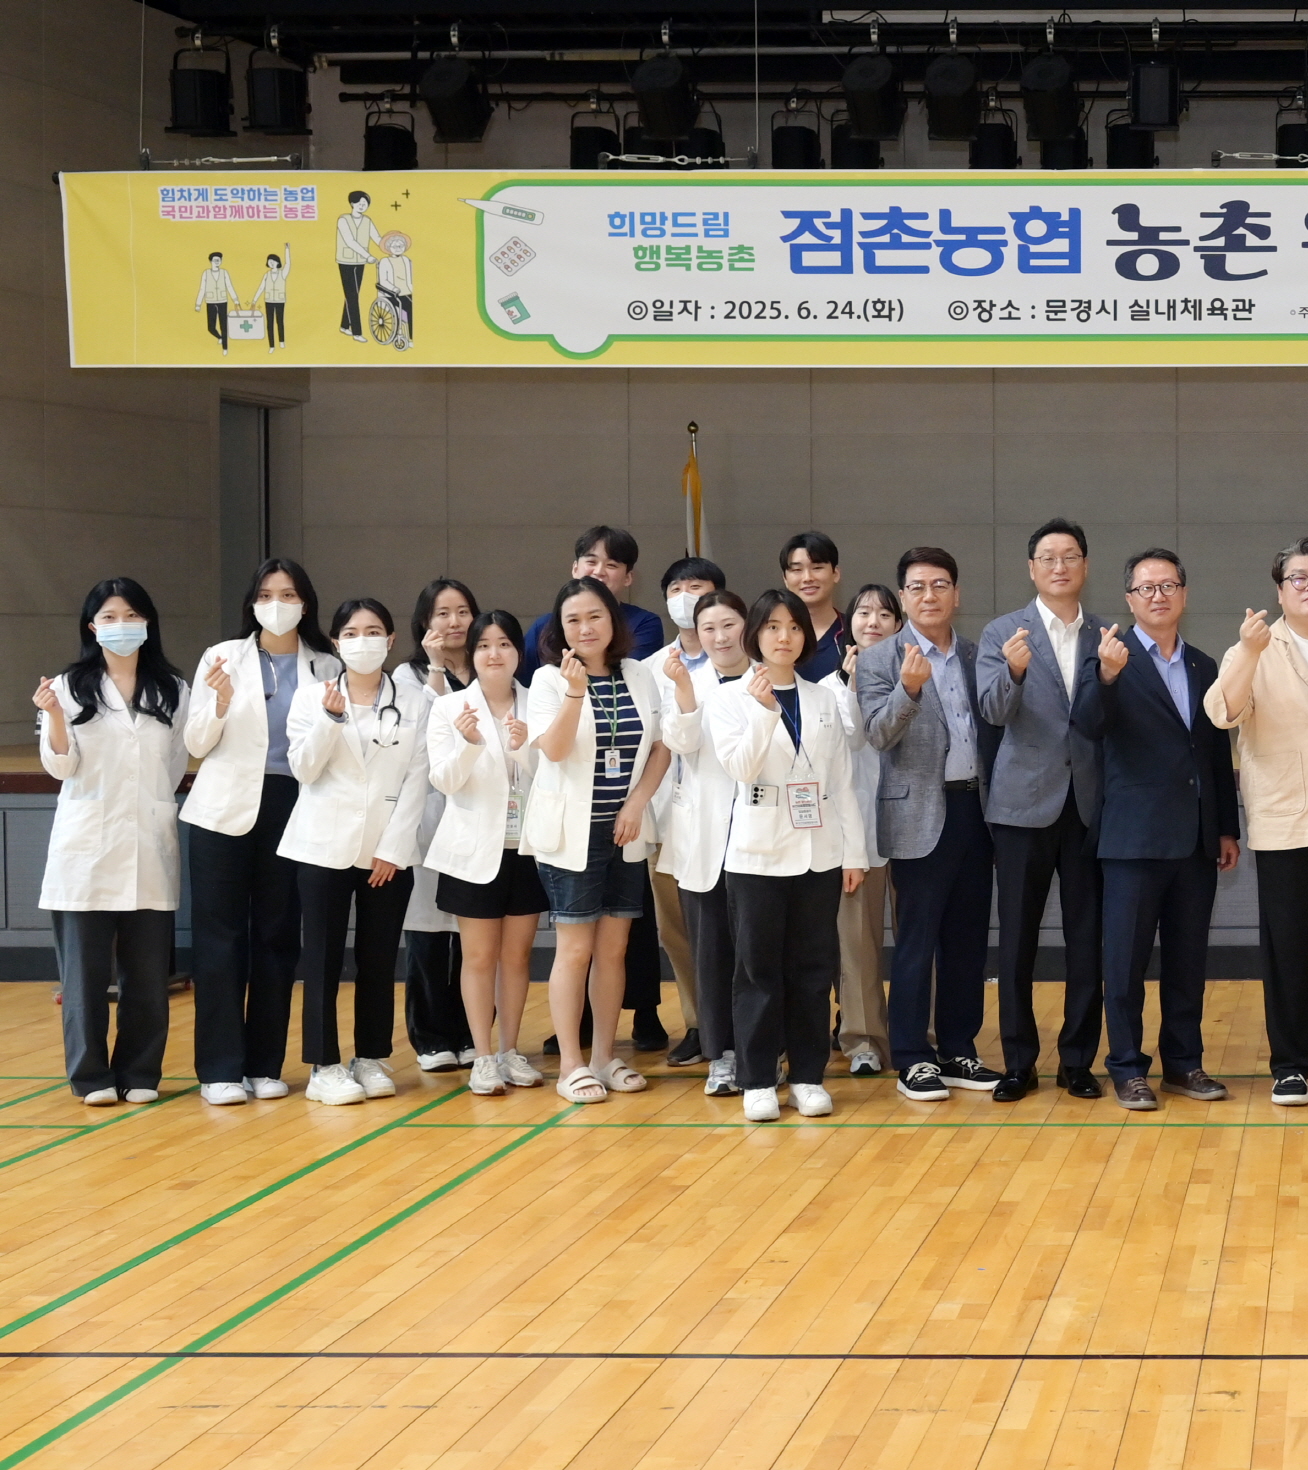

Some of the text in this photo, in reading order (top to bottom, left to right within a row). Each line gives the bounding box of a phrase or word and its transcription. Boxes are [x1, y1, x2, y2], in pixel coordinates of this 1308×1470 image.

[160, 187, 315, 202] 힘차게 도약하는 농업
[161, 204, 315, 219] 국민과함께하는 농촌
[608, 212, 729, 239] 희망드림
[780, 206, 1082, 276] 점촌농협
[1106, 200, 1277, 281] 농촌
[633, 245, 755, 272] 행복농촌
[724, 301, 789, 320] 2025.
[797, 301, 817, 320] 6.
[826, 298, 904, 322] 24.(화)
[1045, 299, 1118, 323] 문경시
[1129, 297, 1256, 322] 실내체육관
